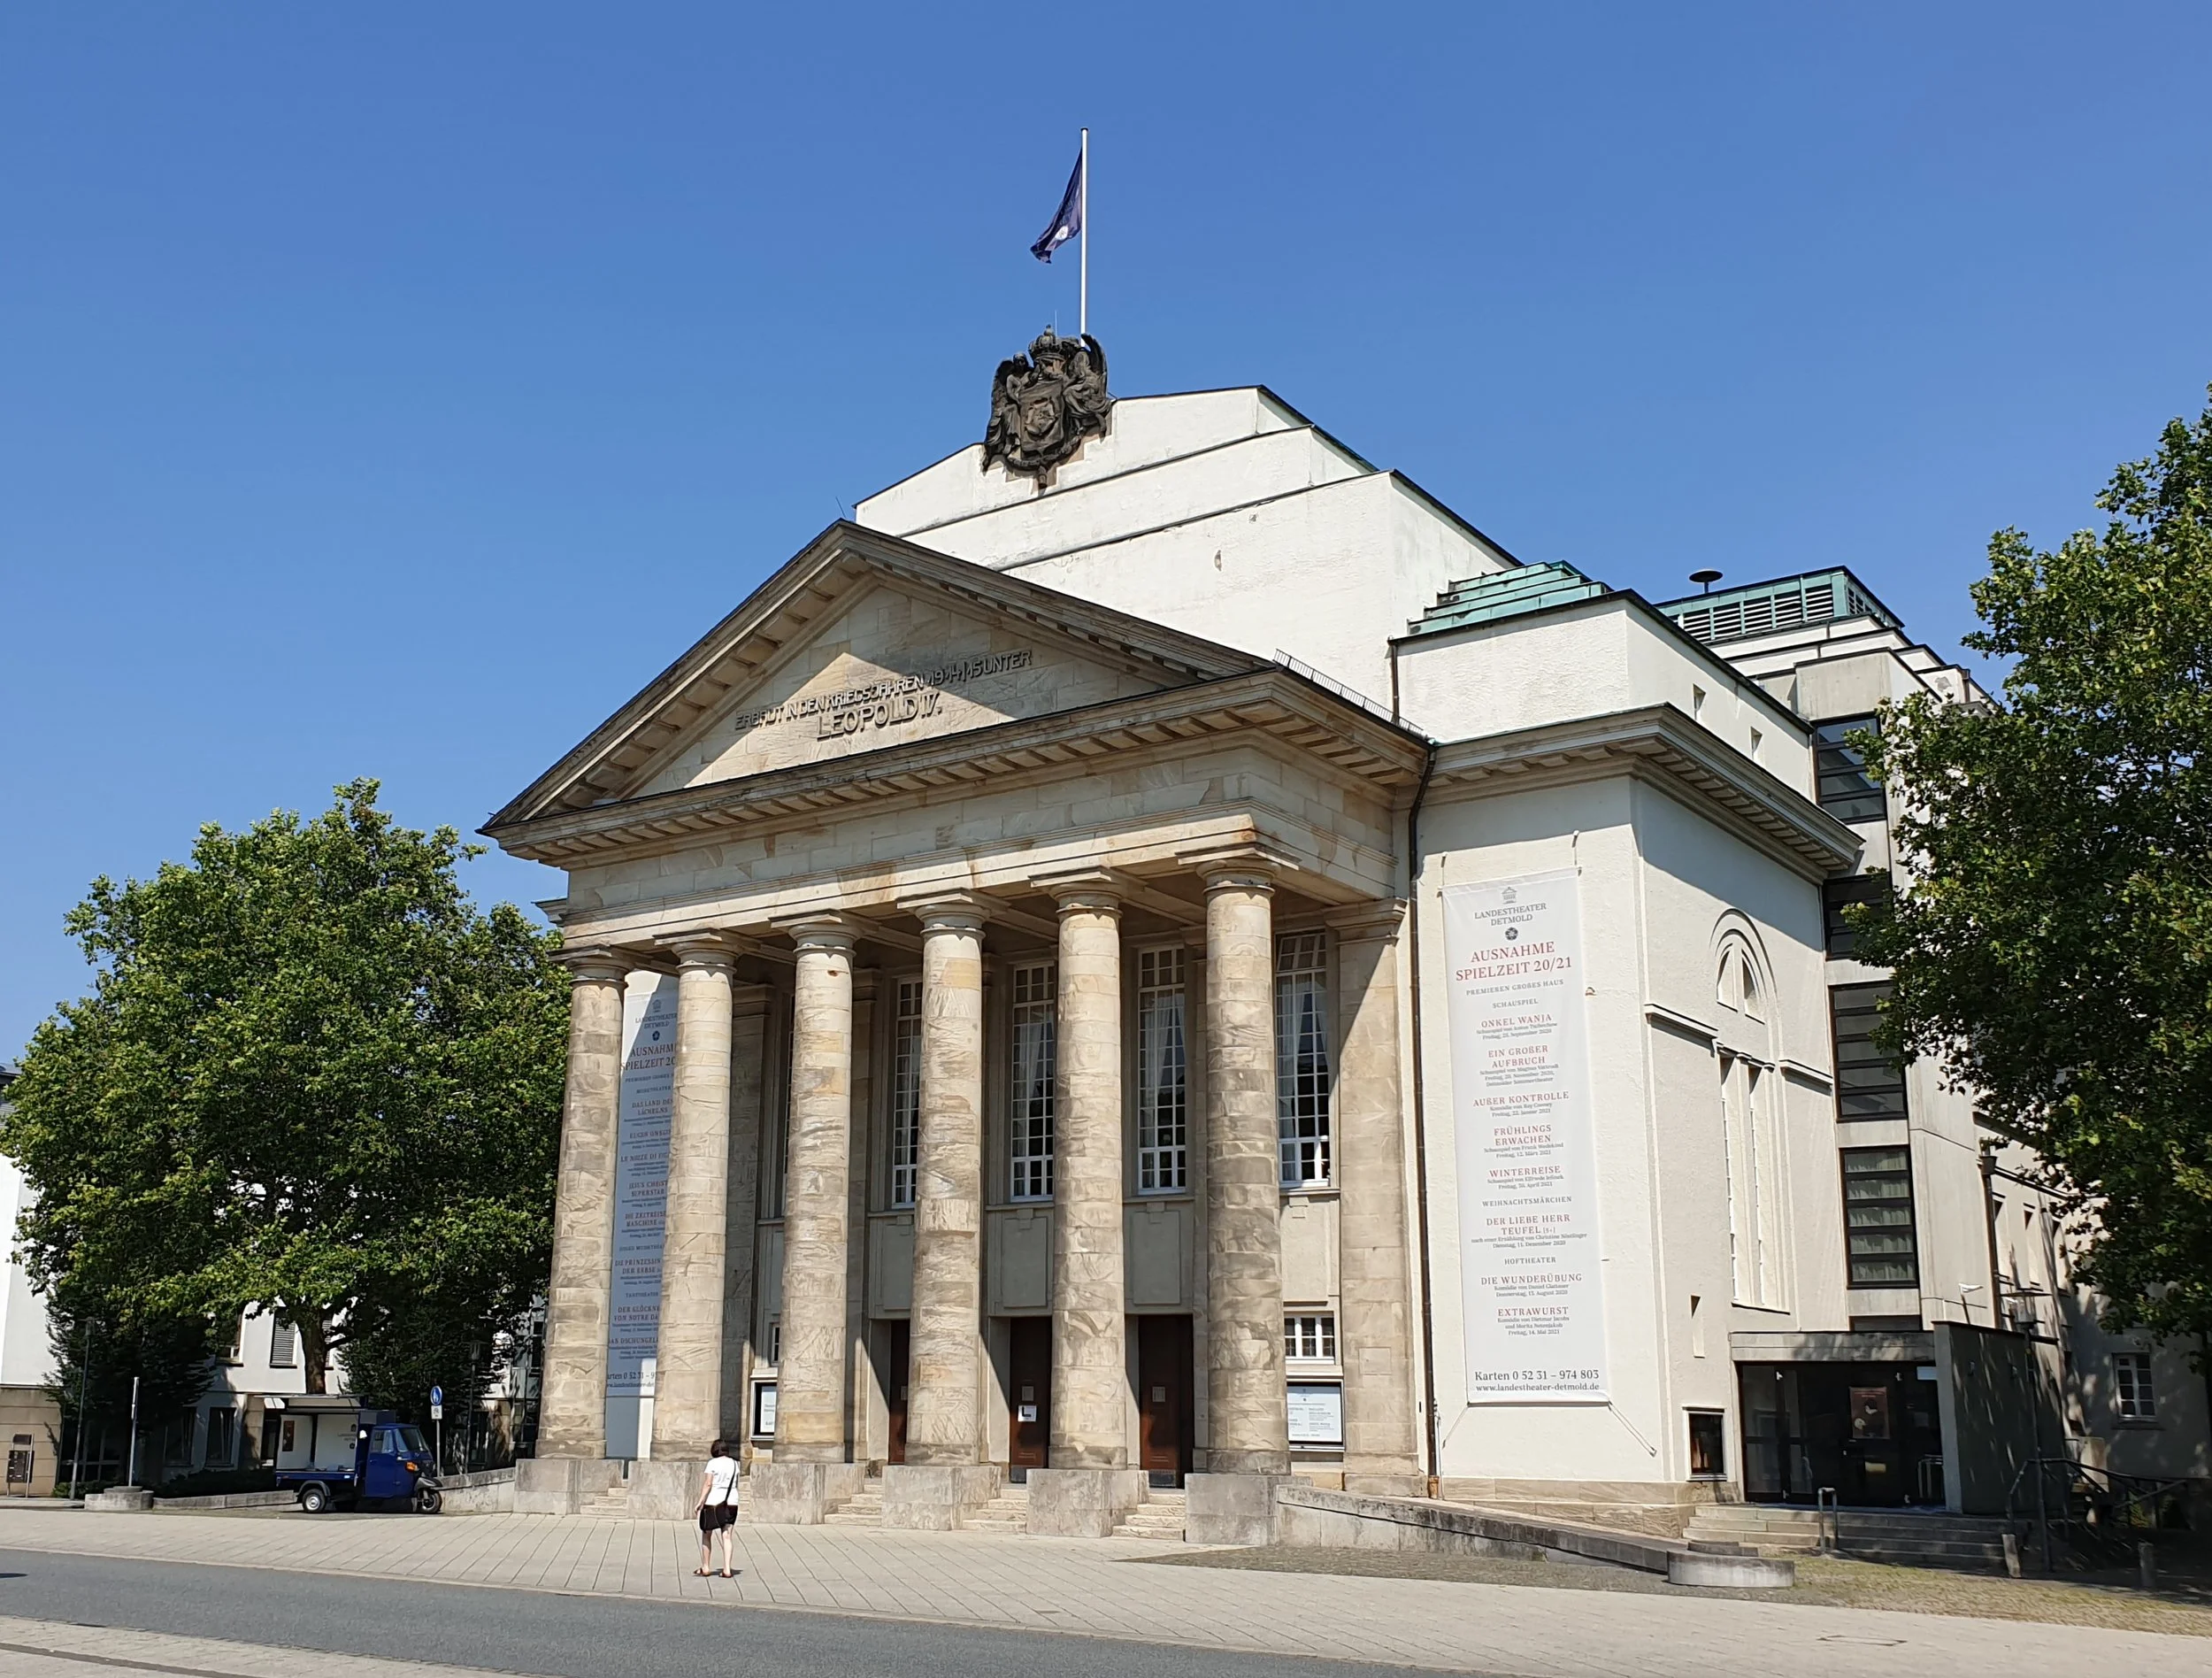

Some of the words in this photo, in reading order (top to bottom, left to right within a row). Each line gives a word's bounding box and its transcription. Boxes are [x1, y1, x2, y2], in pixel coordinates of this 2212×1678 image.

[735, 705, 784, 730] ERBAUT
[787, 702, 799, 721] IN
[800, 695, 826, 719] DEN
[983, 650, 1033, 675] UNTER
[818, 695, 919, 742] LEOPOLD
[1474, 903, 1547, 920] LANDESTHEATER
[1491, 914, 1533, 927] DETMOLD
[1471, 941, 1555, 963] AUSNAHME
[1455, 961, 1531, 981] SPIELZEIT
[1533, 957, 1572, 973] 20/21
[1466, 985, 1510, 996] PREMIEREN
[1543, 979, 1564, 988] HAUS
[1492, 998, 1539, 1009] SCHAUSPIEL
[1480, 1017, 1515, 1028] ONKEL
[1517, 1013, 1553, 1024] WANJA
[1488, 1050, 1506, 1058] EIN
[1492, 1056, 1546, 1068] AUFBRUCH
[1509, 1090, 1570, 1104] KONTROLLE
[1494, 1125, 1552, 1136] FRÜHLINGS
[1495, 1135, 1552, 1146] ERWACHEN
[1489, 1166, 1561, 1178] WINTERREISE
[1482, 1196, 1572, 1207] WEIHNACHTSMÄRCHEN
[1486, 1217, 1507, 1227] DER
[1509, 1215, 1540, 1225] LIEBE
[1542, 1213, 1571, 1223] HERR
[1501, 1226, 1541, 1235] TEUFEL
[1504, 1257, 1556, 1266] HOFTHEATER
[1481, 1276, 1498, 1286] DIE
[1501, 1273, 1583, 1285] WUNDERÜBUNG
[1497, 1306, 1569, 1317] EXTRAWURST
[1475, 1371, 1509, 1381] Karten
[1512, 1371, 1518, 1380] 0
[1521, 1370, 1533, 1380] 52
[1536, 1370, 1548, 1380] 31
[1559, 1369, 1577, 1380] 974
[1580, 1369, 1600, 1380] 803
[1476, 1382, 1600, 1392] www.landestheater-detmold.de
